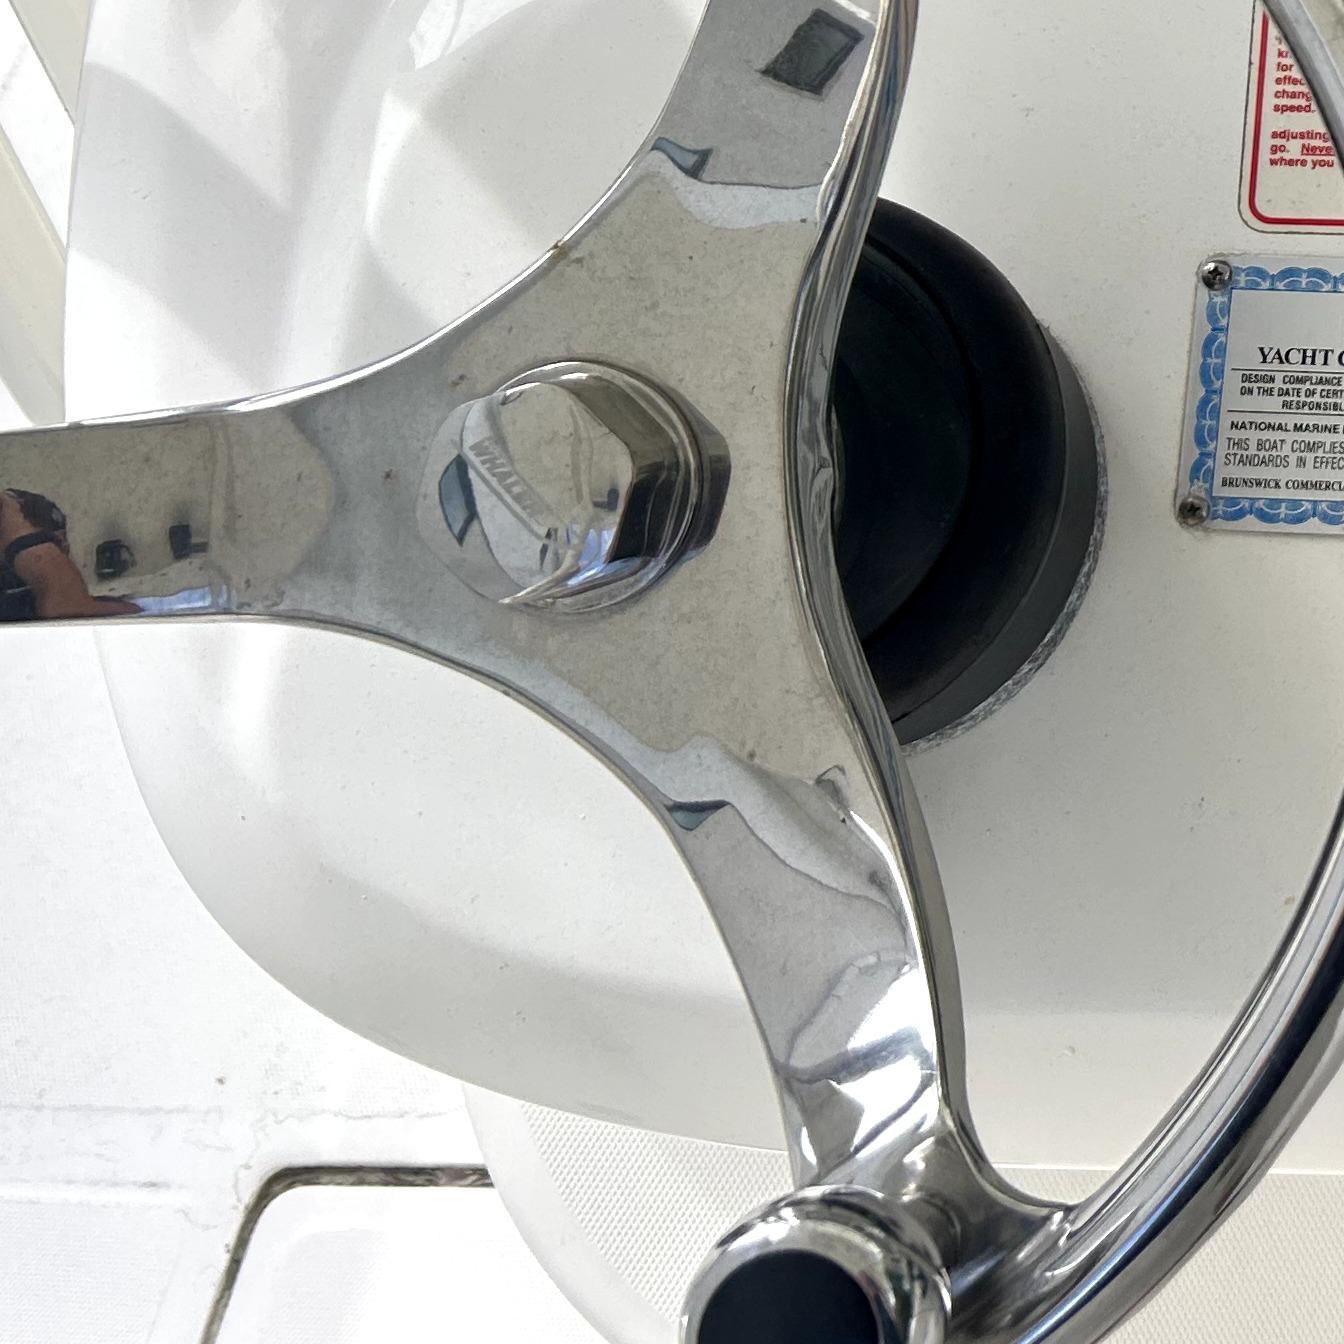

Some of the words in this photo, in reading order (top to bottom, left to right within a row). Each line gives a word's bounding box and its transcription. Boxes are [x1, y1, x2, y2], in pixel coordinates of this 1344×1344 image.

[1274, 103, 1316, 114] speed.
[1258, 347, 1333, 365] YACHT
[1241, 373, 1275, 387] DESIGN
[1283, 375, 1341, 385] COMPLIANCE
[1240, 386, 1253, 395] ON
[1257, 386, 1274, 396] THE
[1277, 387, 1301, 400] DATE
[1305, 388, 1316, 397] OF
[1230, 421, 1290, 431] NATIONAL
[1293, 423, 1339, 433] MARINE
[1226, 437, 1249, 453] THIS
[1256, 439, 1285, 454] BOAT
[1291, 440, 1344, 453] COMPLIES
[1224, 453, 1289, 468] STANDARDS
[1296, 456, 1306, 468] IN
[1221, 477, 1280, 488] BRUNSWICK
